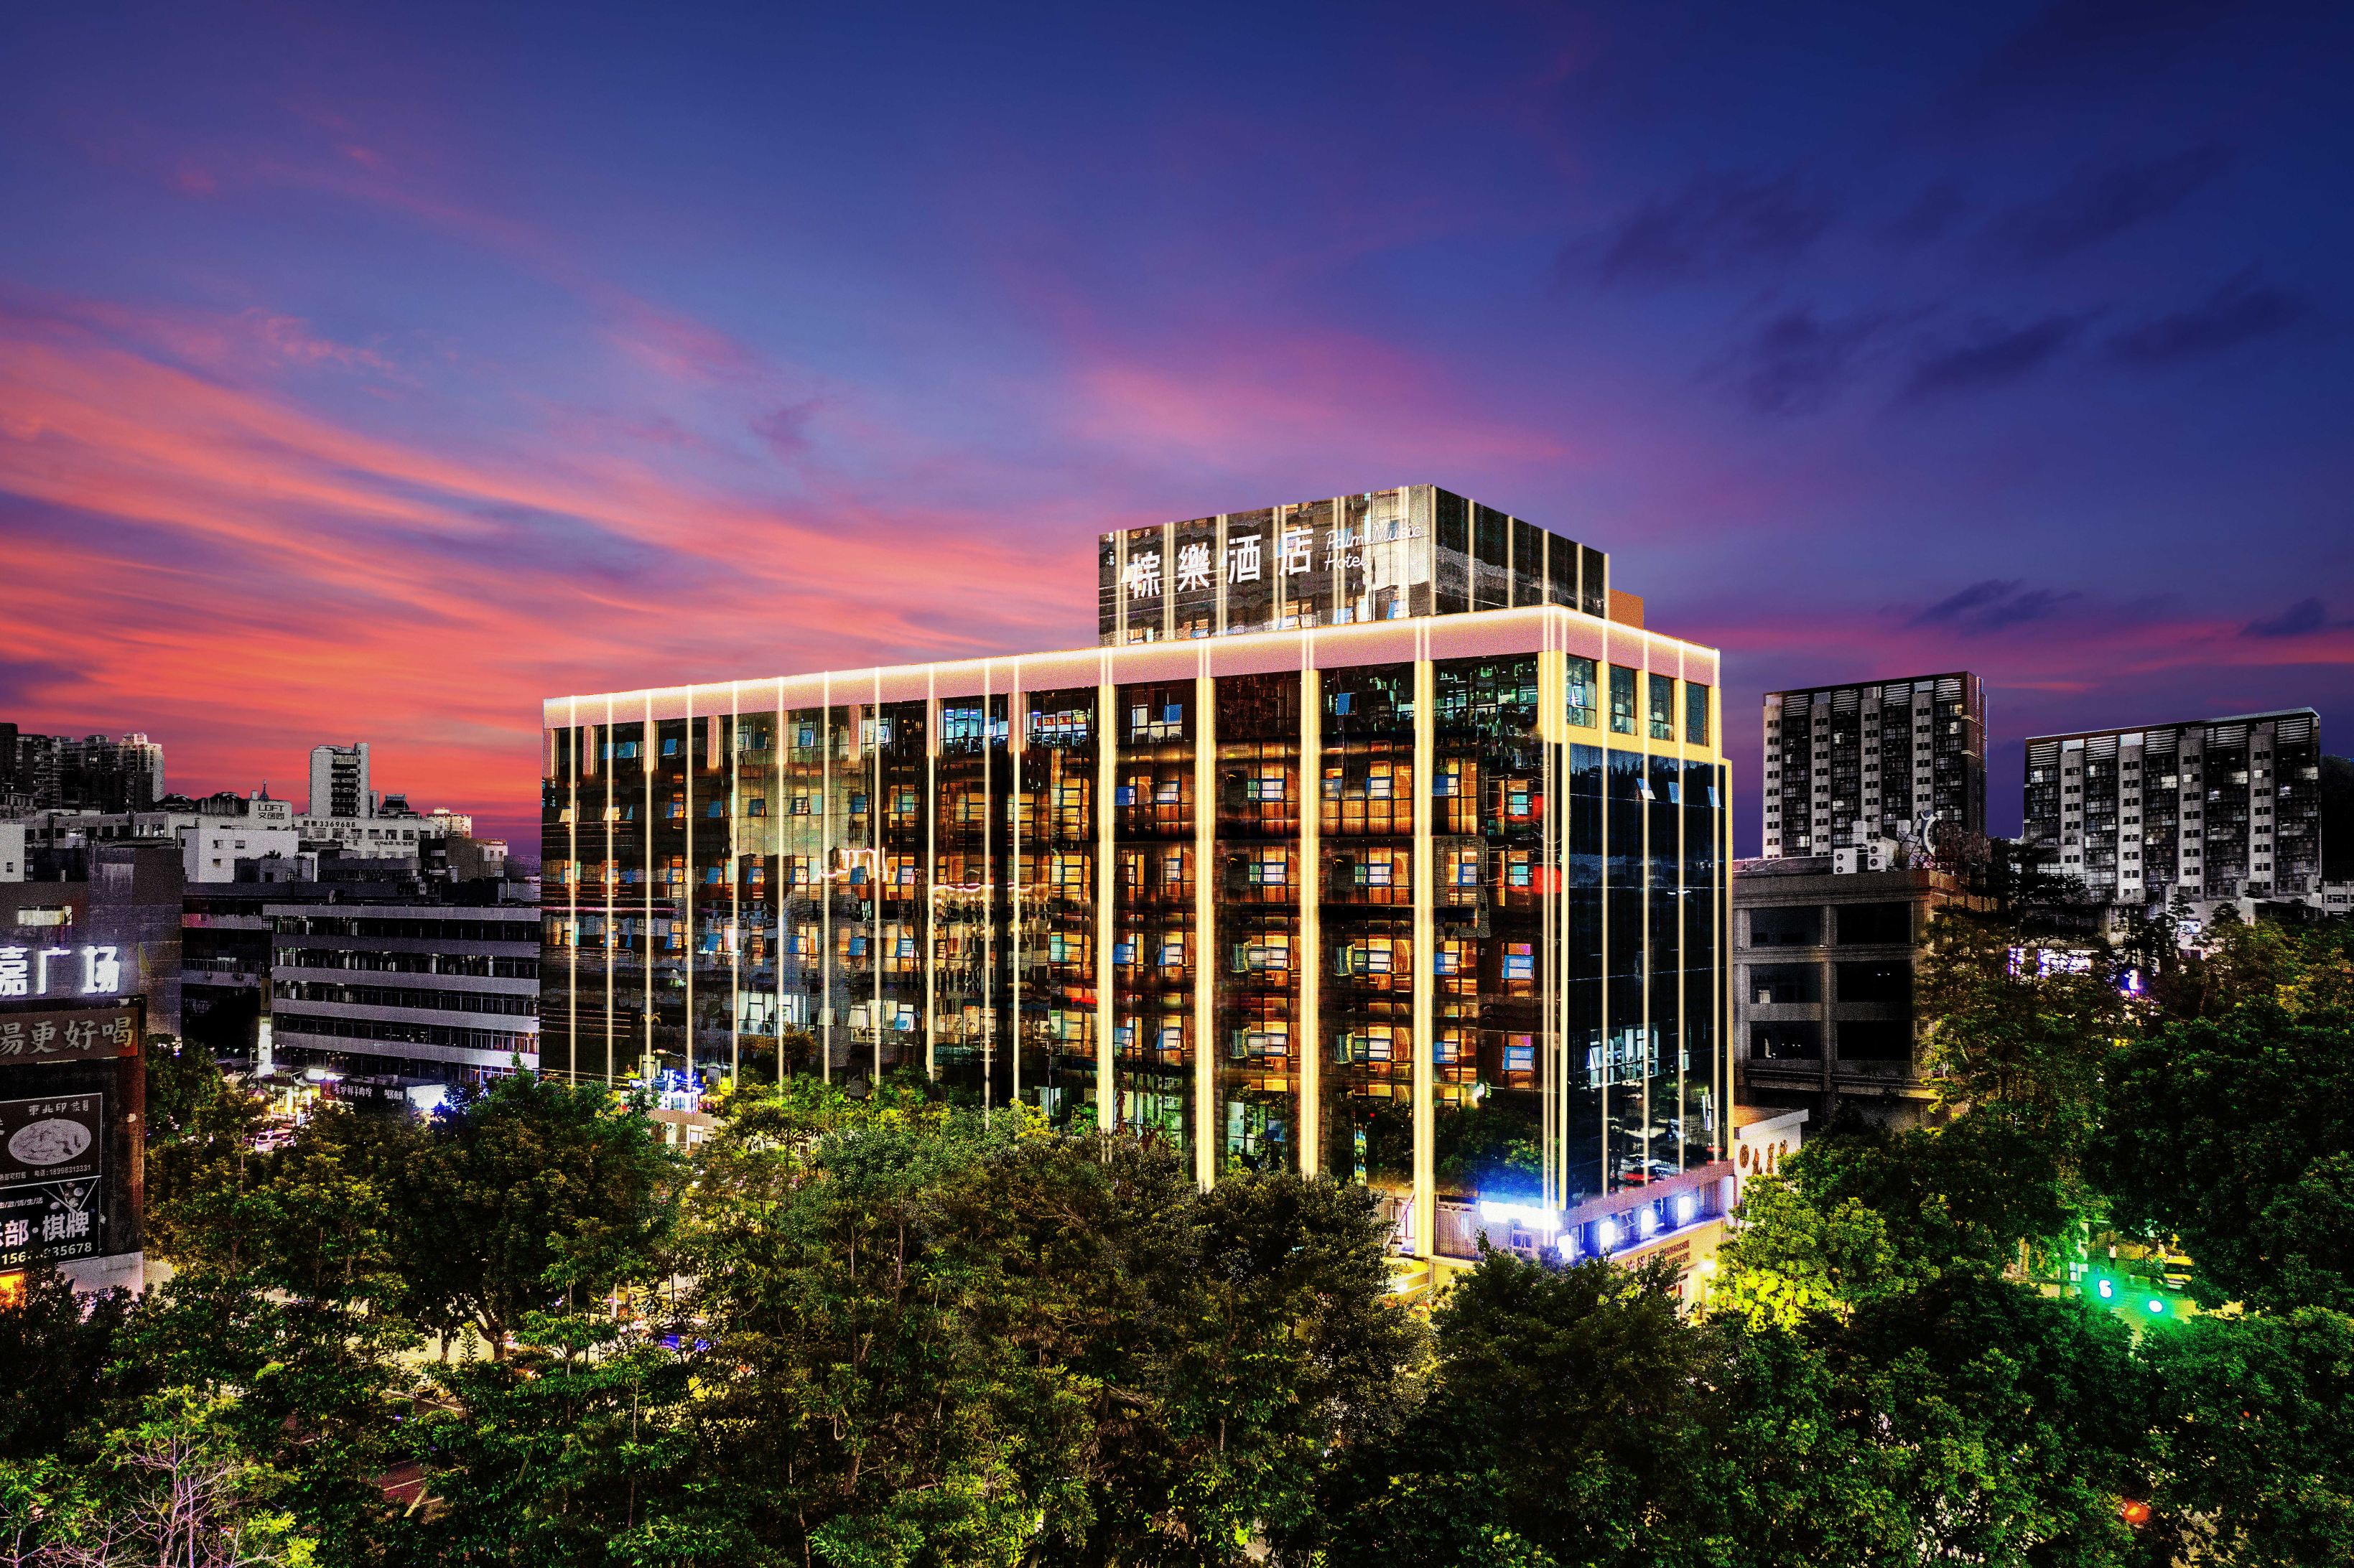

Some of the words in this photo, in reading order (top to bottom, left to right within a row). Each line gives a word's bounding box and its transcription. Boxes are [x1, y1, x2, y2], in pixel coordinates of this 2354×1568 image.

[1326, 527, 1364, 551] Palm
[1369, 523, 1422, 543] Music
[1130, 526, 1313, 599] 棕樂酒店
[1324, 548, 1367, 571] Hotel
[0, 1210, 90, 1248] 部·棋牌
